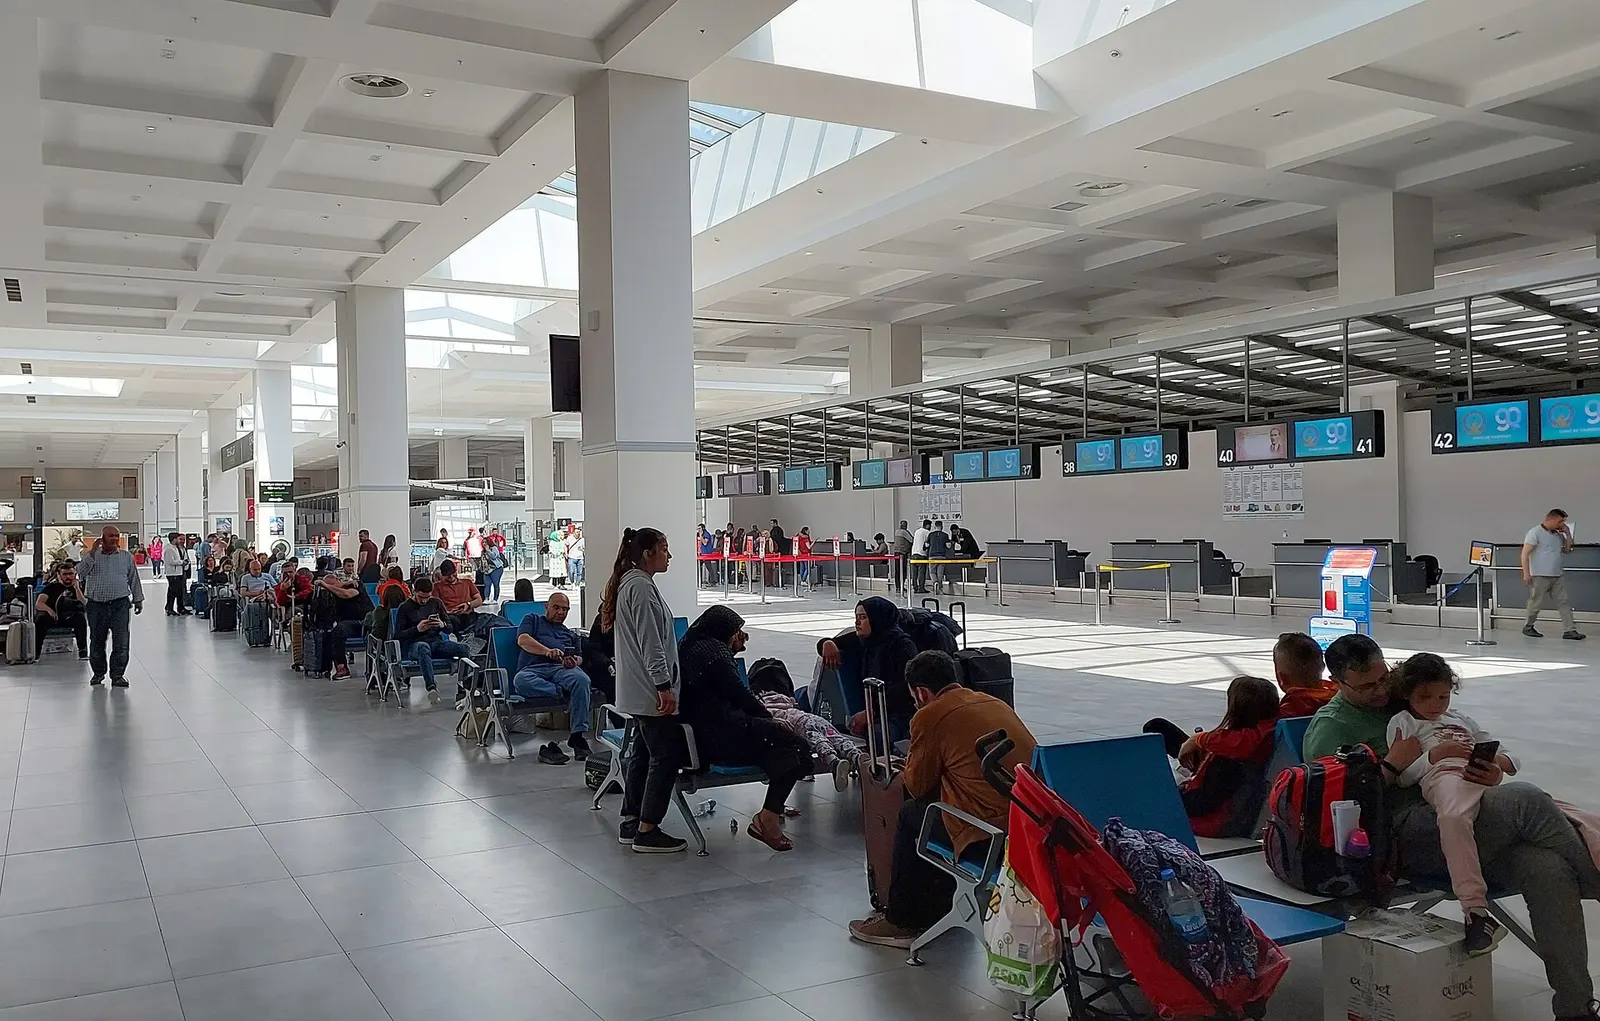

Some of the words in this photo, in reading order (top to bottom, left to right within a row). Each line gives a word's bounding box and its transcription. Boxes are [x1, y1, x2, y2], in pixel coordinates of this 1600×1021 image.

[1494, 406, 1522, 432] 90
[1584, 399, 1600, 425] 9
[1325, 422, 1347, 445] 90
[1356, 438, 1372, 454] 41
[1434, 433, 1454, 449] 42
[1165, 453, 1178, 467] 39
[1219, 449, 1234, 463] 40
[1021, 465, 1032, 476] 37
[1063, 461, 1075, 474] 38
[853, 477, 860, 487] 34
[913, 472, 922, 483] 35
[944, 470, 953, 481] 36
[778, 483, 785, 493] 32
[827, 479, 834, 488] 33
[991, 966, 1030, 988] ASDA
